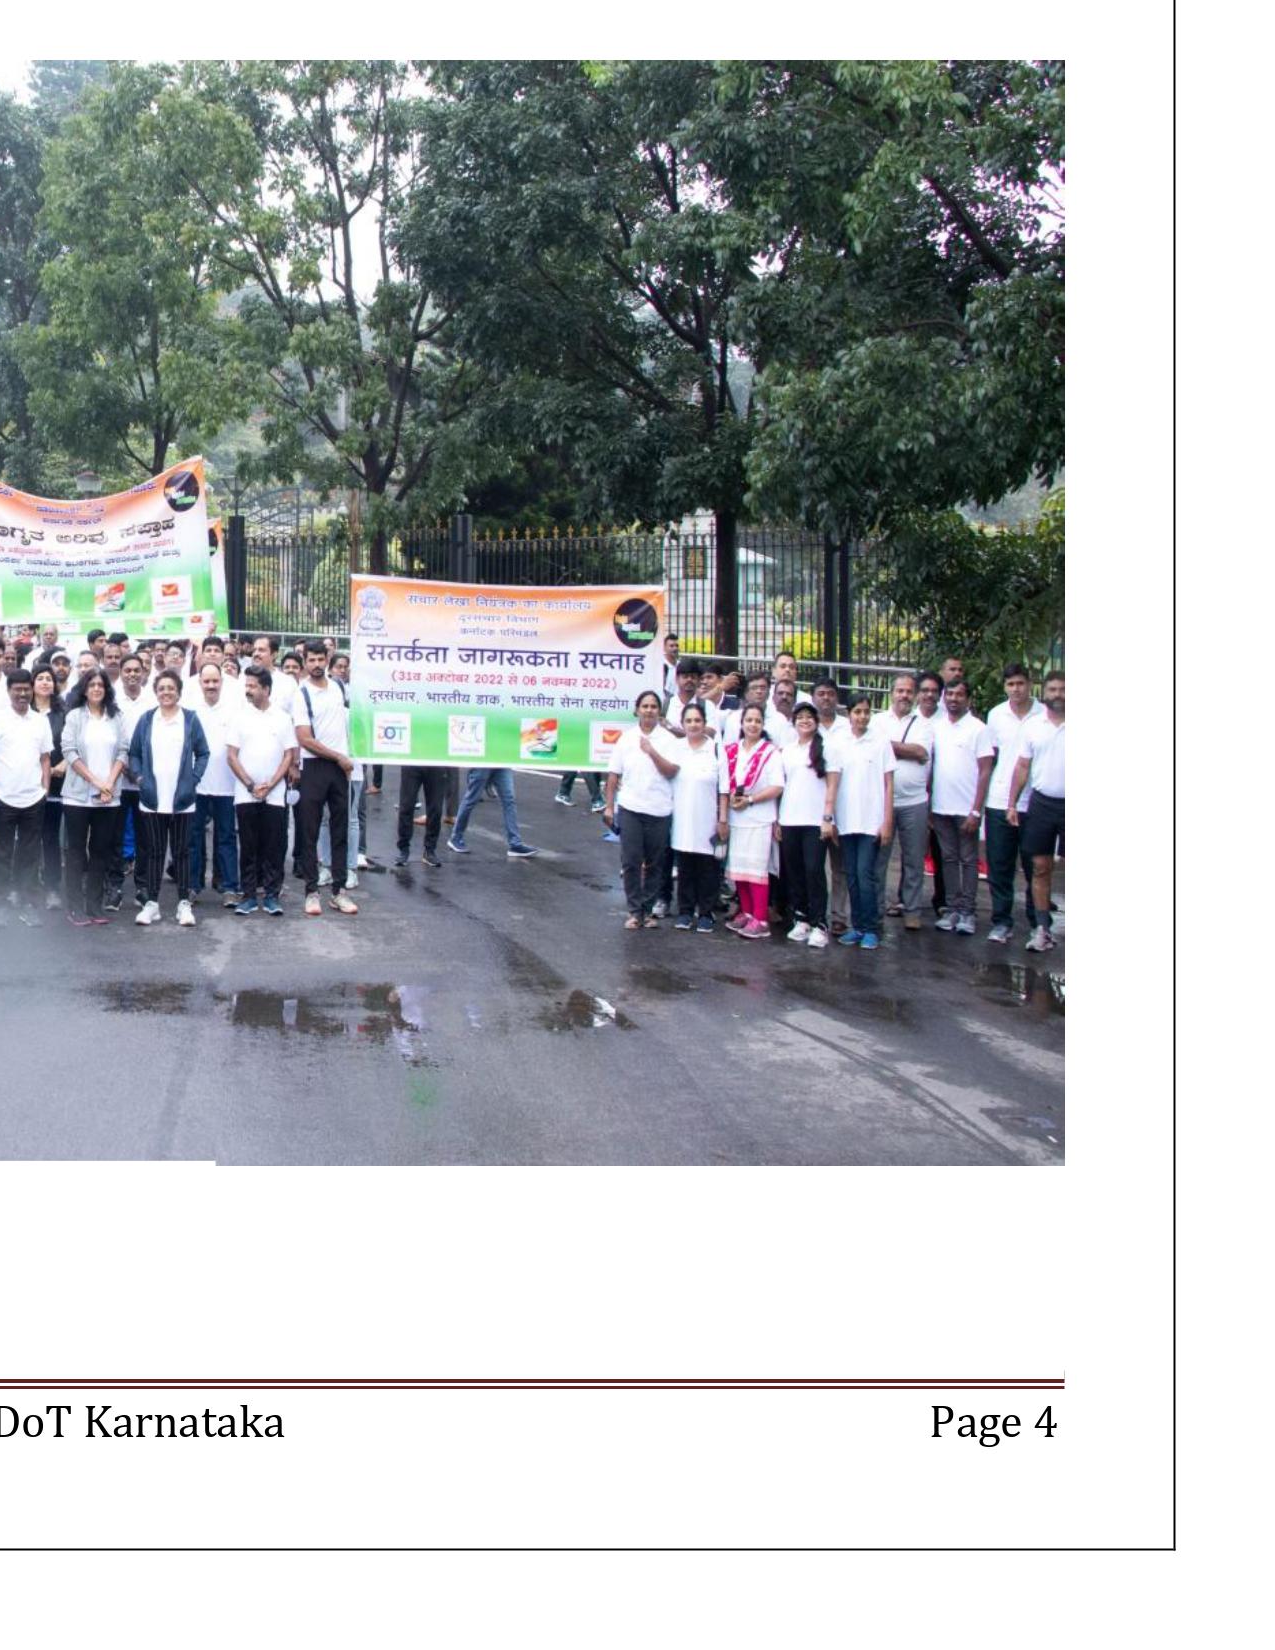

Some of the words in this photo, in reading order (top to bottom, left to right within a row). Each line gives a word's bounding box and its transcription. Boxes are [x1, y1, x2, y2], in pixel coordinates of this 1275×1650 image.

[366, 638, 450, 663] सतर्कता
[457, 647, 571, 668] जागरूकता
[579, 652, 646, 674] सप्ताह
[474, 673, 503, 685] 2022
[522, 675, 537, 685] 06
[426, 689, 471, 704] भारतीय
[511, 693, 555, 708] भारतीय
[559, 694, 584, 709] सेना
[589, 696, 629, 711] सहयोग
